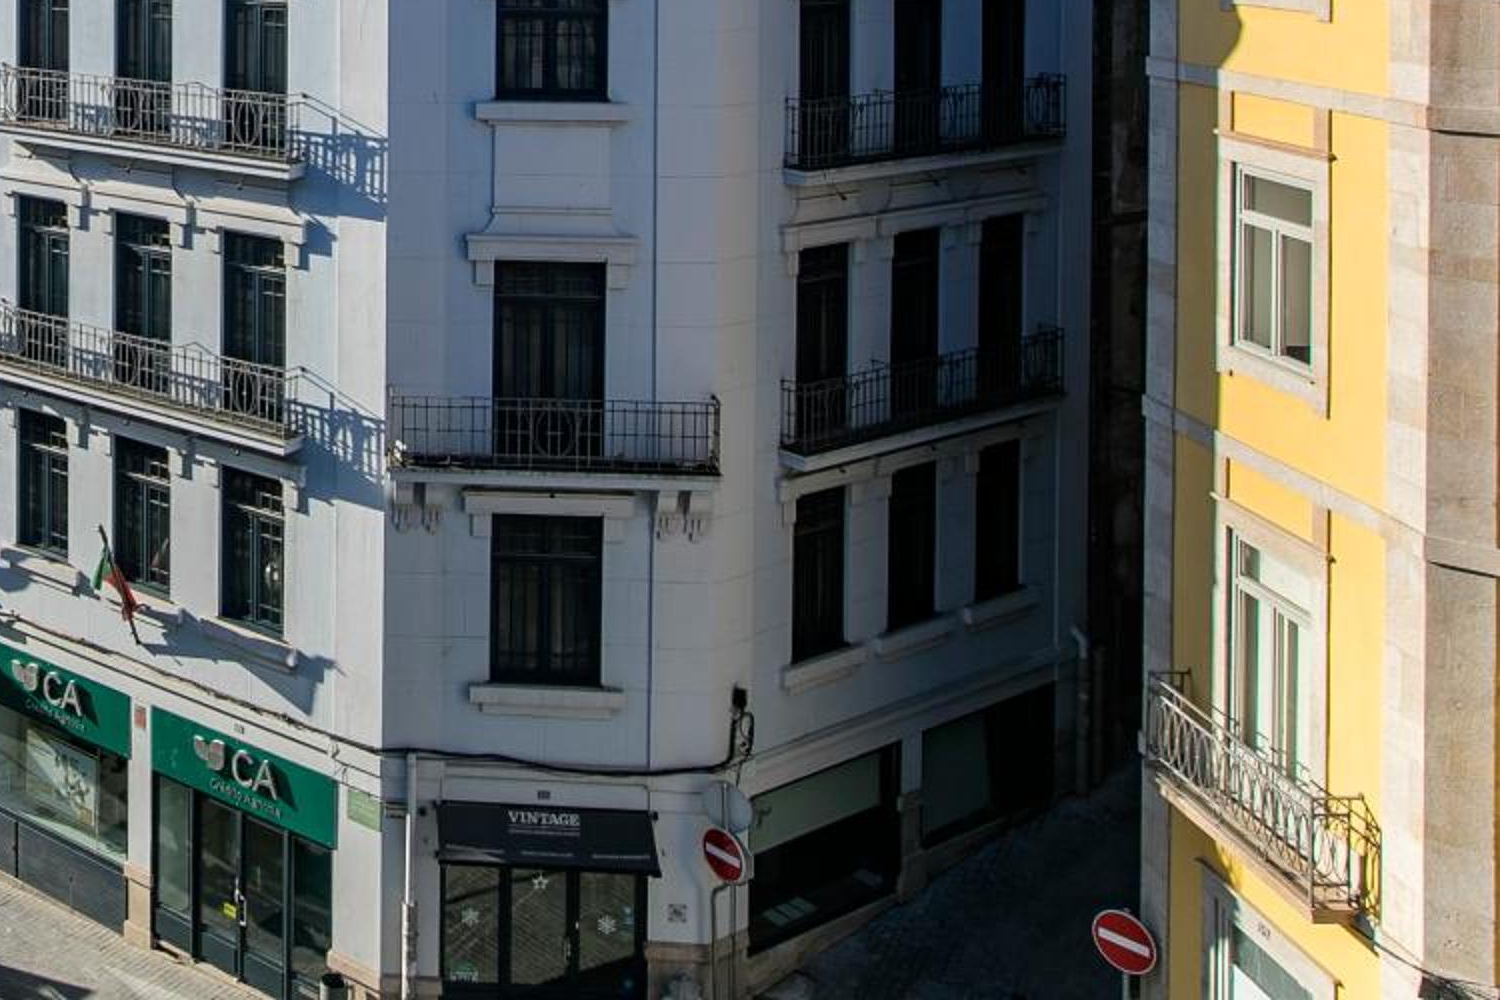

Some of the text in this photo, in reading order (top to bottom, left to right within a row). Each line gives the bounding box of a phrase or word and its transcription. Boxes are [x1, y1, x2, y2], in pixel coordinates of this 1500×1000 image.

[43, 671, 82, 717] CA
[231, 749, 278, 801] CA
[507, 810, 581, 827] VINTAGE
